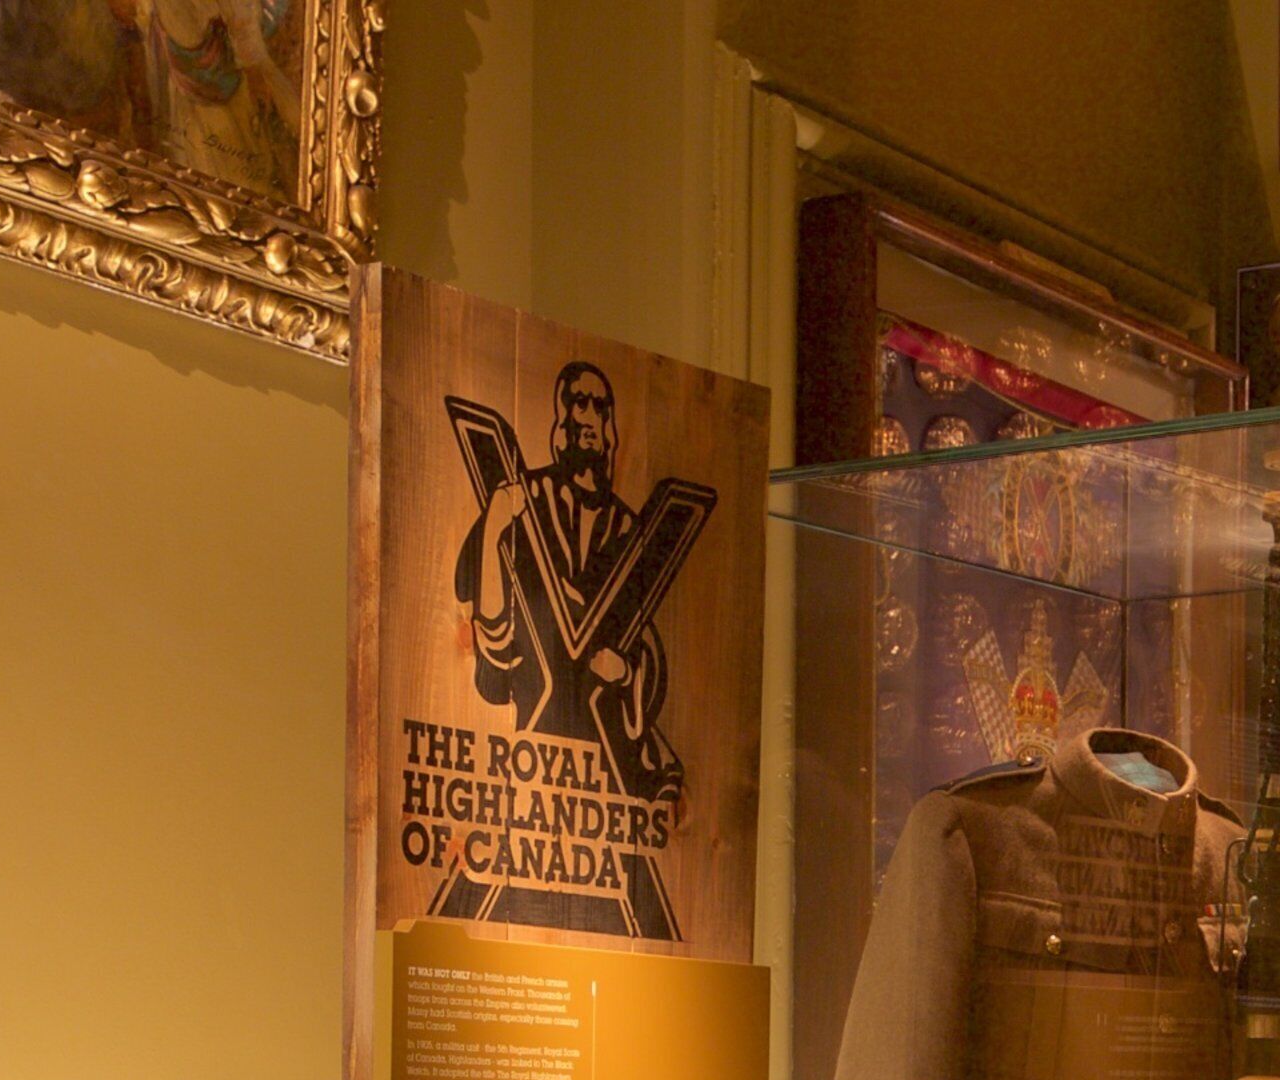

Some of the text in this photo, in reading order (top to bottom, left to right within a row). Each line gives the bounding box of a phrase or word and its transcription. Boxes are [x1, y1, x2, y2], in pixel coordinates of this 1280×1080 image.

[404, 720, 601, 792] THE ROYAL
[403, 771, 669, 848] HIGHLANDERS
[402, 822, 621, 889] OF CANADA
[409, 967, 416, 975] IT
[418, 968, 433, 976] WAS
[435, 969, 450, 978] NOT
[452, 970, 470, 979] ONLY
